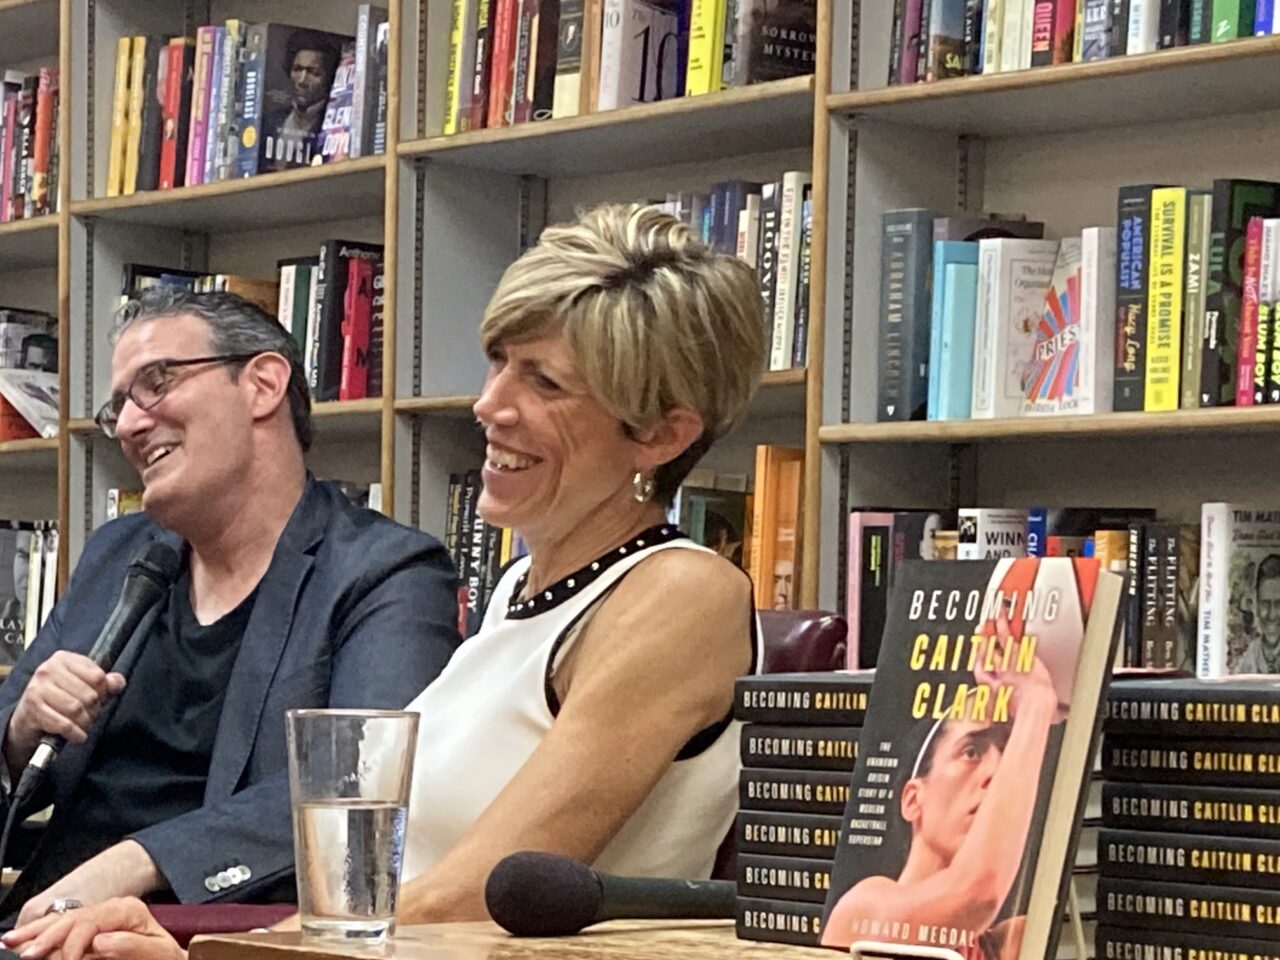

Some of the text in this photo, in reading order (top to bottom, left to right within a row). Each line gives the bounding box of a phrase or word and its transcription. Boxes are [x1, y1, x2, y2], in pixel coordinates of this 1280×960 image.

[1160, 201, 1176, 259] SURVIVAL
[1131, 216, 1144, 290] AMERICAN
[1160, 261, 1174, 277] IS
[1187, 253, 1200, 293] ZAMI
[1159, 280, 1173, 291] A
[1157, 292, 1173, 349] PROMISE
[1254, 351, 1266, 387] BOY
[467, 576, 479, 613] BOY
[909, 590, 1060, 621] BECOMING
[1146, 556, 1158, 627] FLITTING
[1164, 556, 1177, 627] FLITTING
[910, 634, 1037, 673] CAITLIN
[744, 691, 810, 709] BECOMING
[912, 682, 1014, 722] CLARK
[1185, 703, 1246, 722] CAITLIN
[749, 738, 813, 756] BECOMING
[1112, 749, 1188, 769] BECOMING
[1194, 753, 1253, 773] CAITLIN
[748, 781, 811, 801] BECOMING
[1112, 797, 1188, 818] BECOMING
[1194, 802, 1253, 823] CAITLIN
[745, 824, 810, 844] BECOMING
[1109, 844, 1185, 867] BECOMING
[1191, 850, 1252, 872] CAITLIN
[746, 867, 810, 888] BECOMING
[744, 911, 808, 932] BECOMING
[1108, 893, 1184, 917] BECOMING
[1190, 900, 1251, 922] CAITLIN
